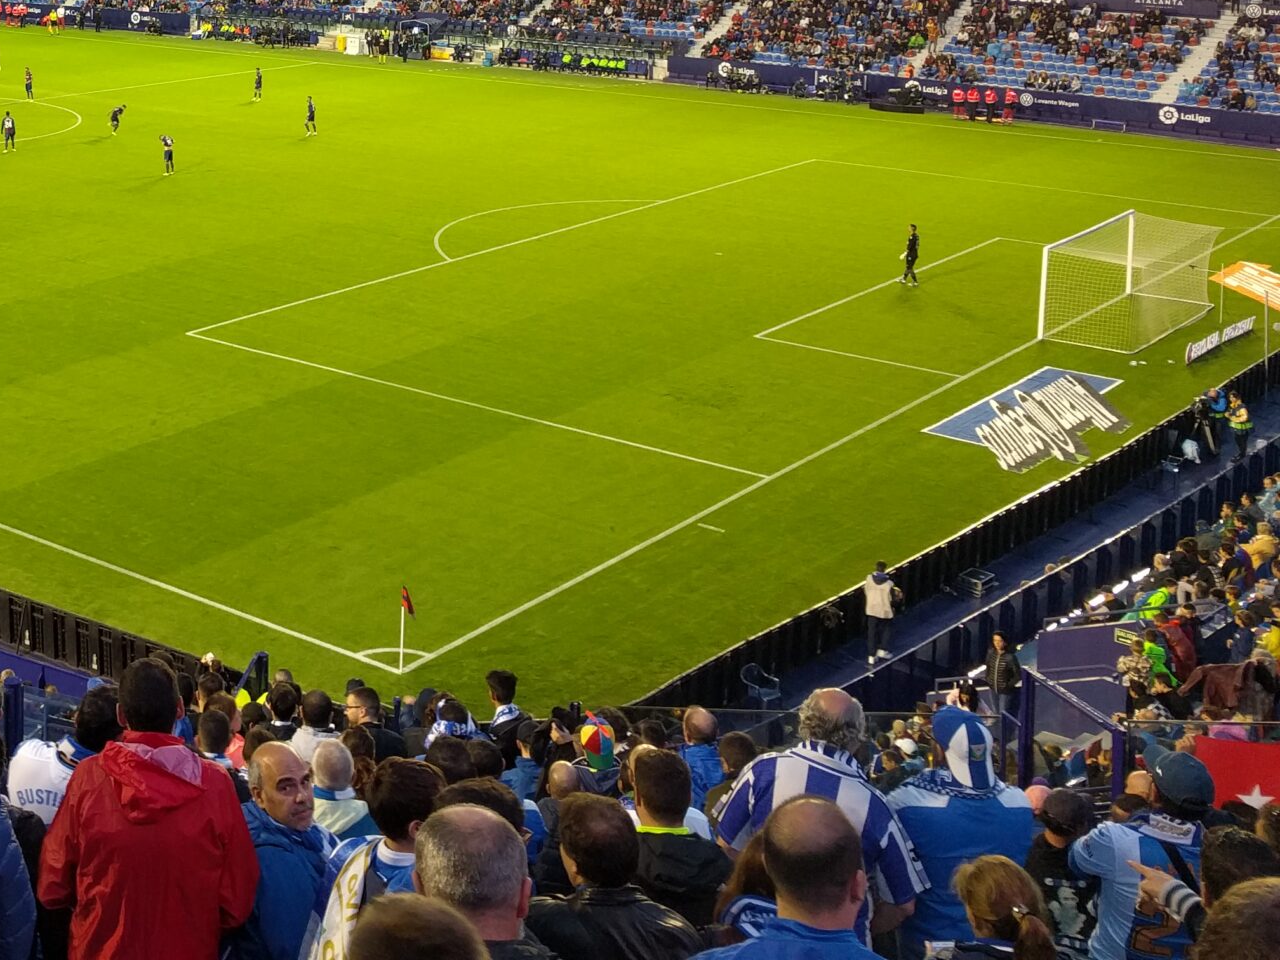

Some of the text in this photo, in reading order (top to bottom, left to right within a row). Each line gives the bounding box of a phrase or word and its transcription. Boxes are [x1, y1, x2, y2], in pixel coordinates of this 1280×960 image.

[923, 86, 948, 95] LaLiga
[1034, 97, 1057, 105] Levante
[1058, 99, 1079, 108] Wagen
[1180, 112, 1211, 124] LaLiga
[16, 788, 64, 807] BUSTI
